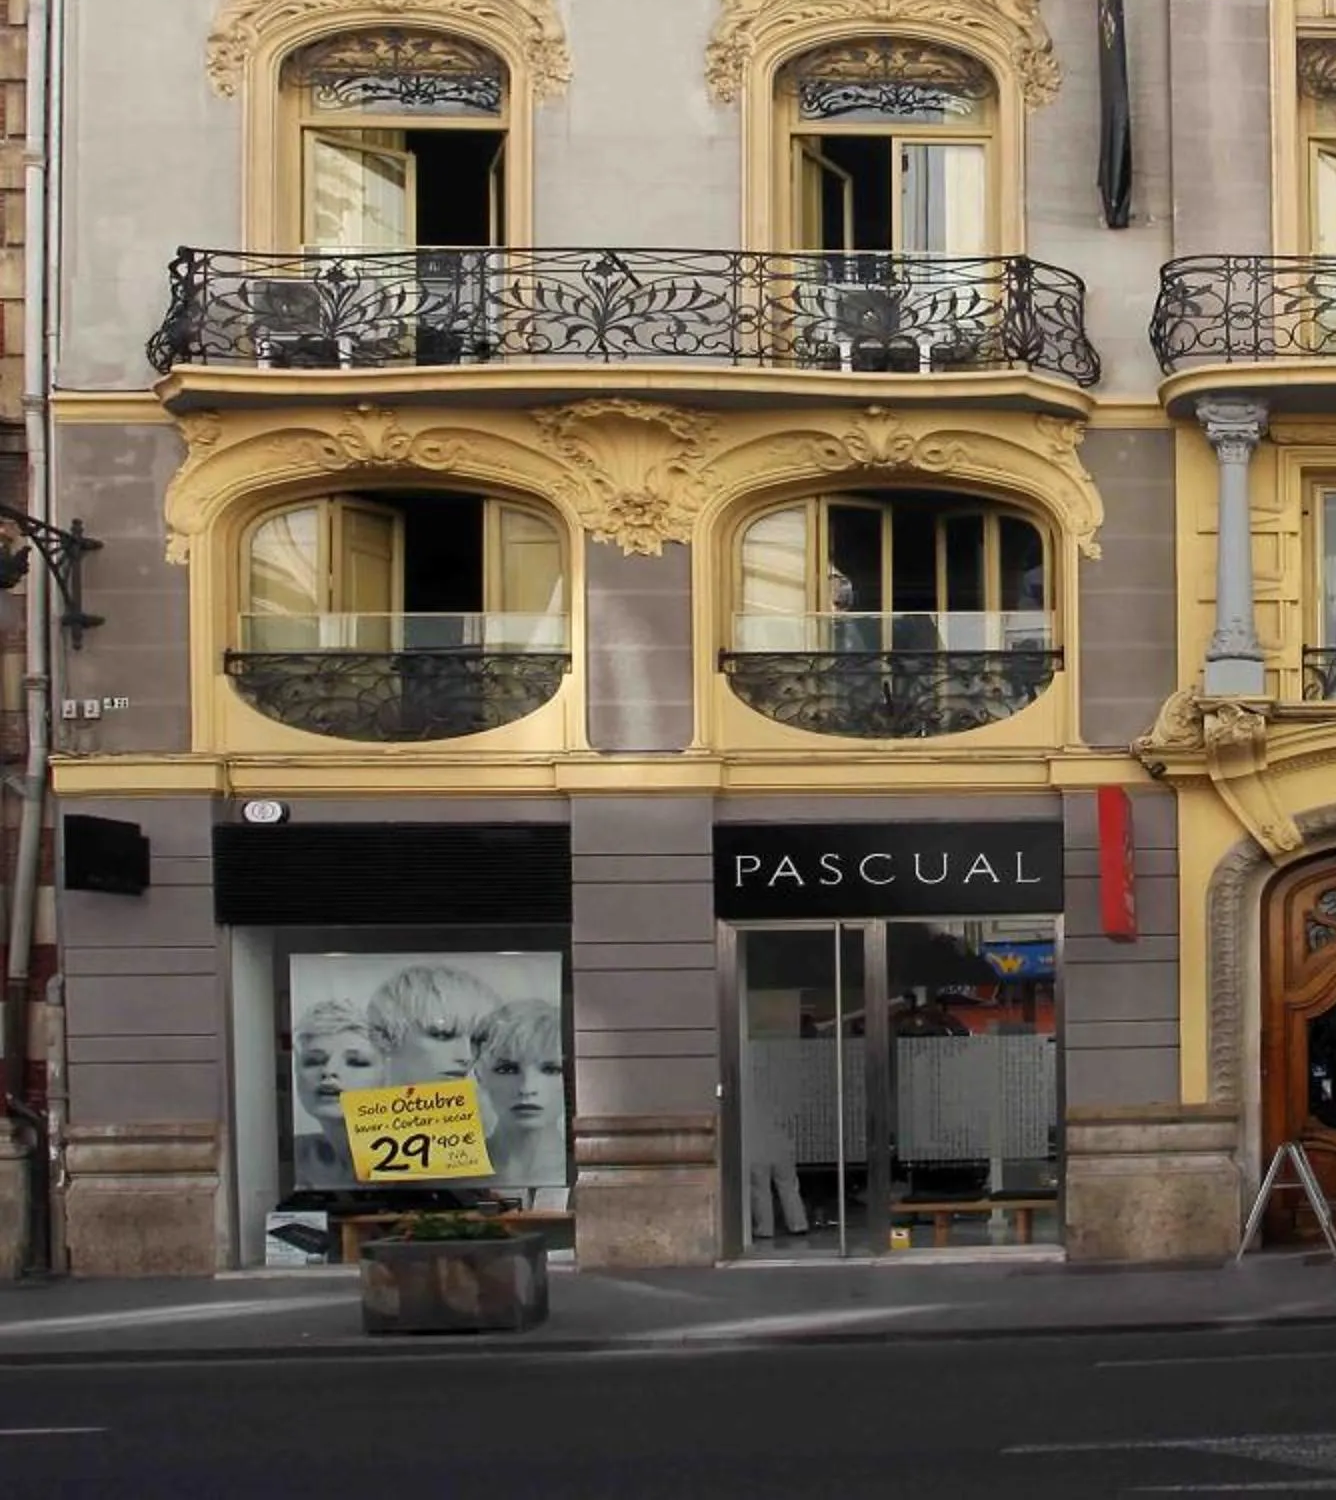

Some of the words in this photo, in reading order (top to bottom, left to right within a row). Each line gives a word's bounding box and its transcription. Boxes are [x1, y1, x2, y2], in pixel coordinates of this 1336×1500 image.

[735, 851, 1041, 887] PASCUAL
[357, 1103, 387, 1117] Solo
[391, 1091, 465, 1114] Octubre
[391, 1116, 432, 1131] Cortar
